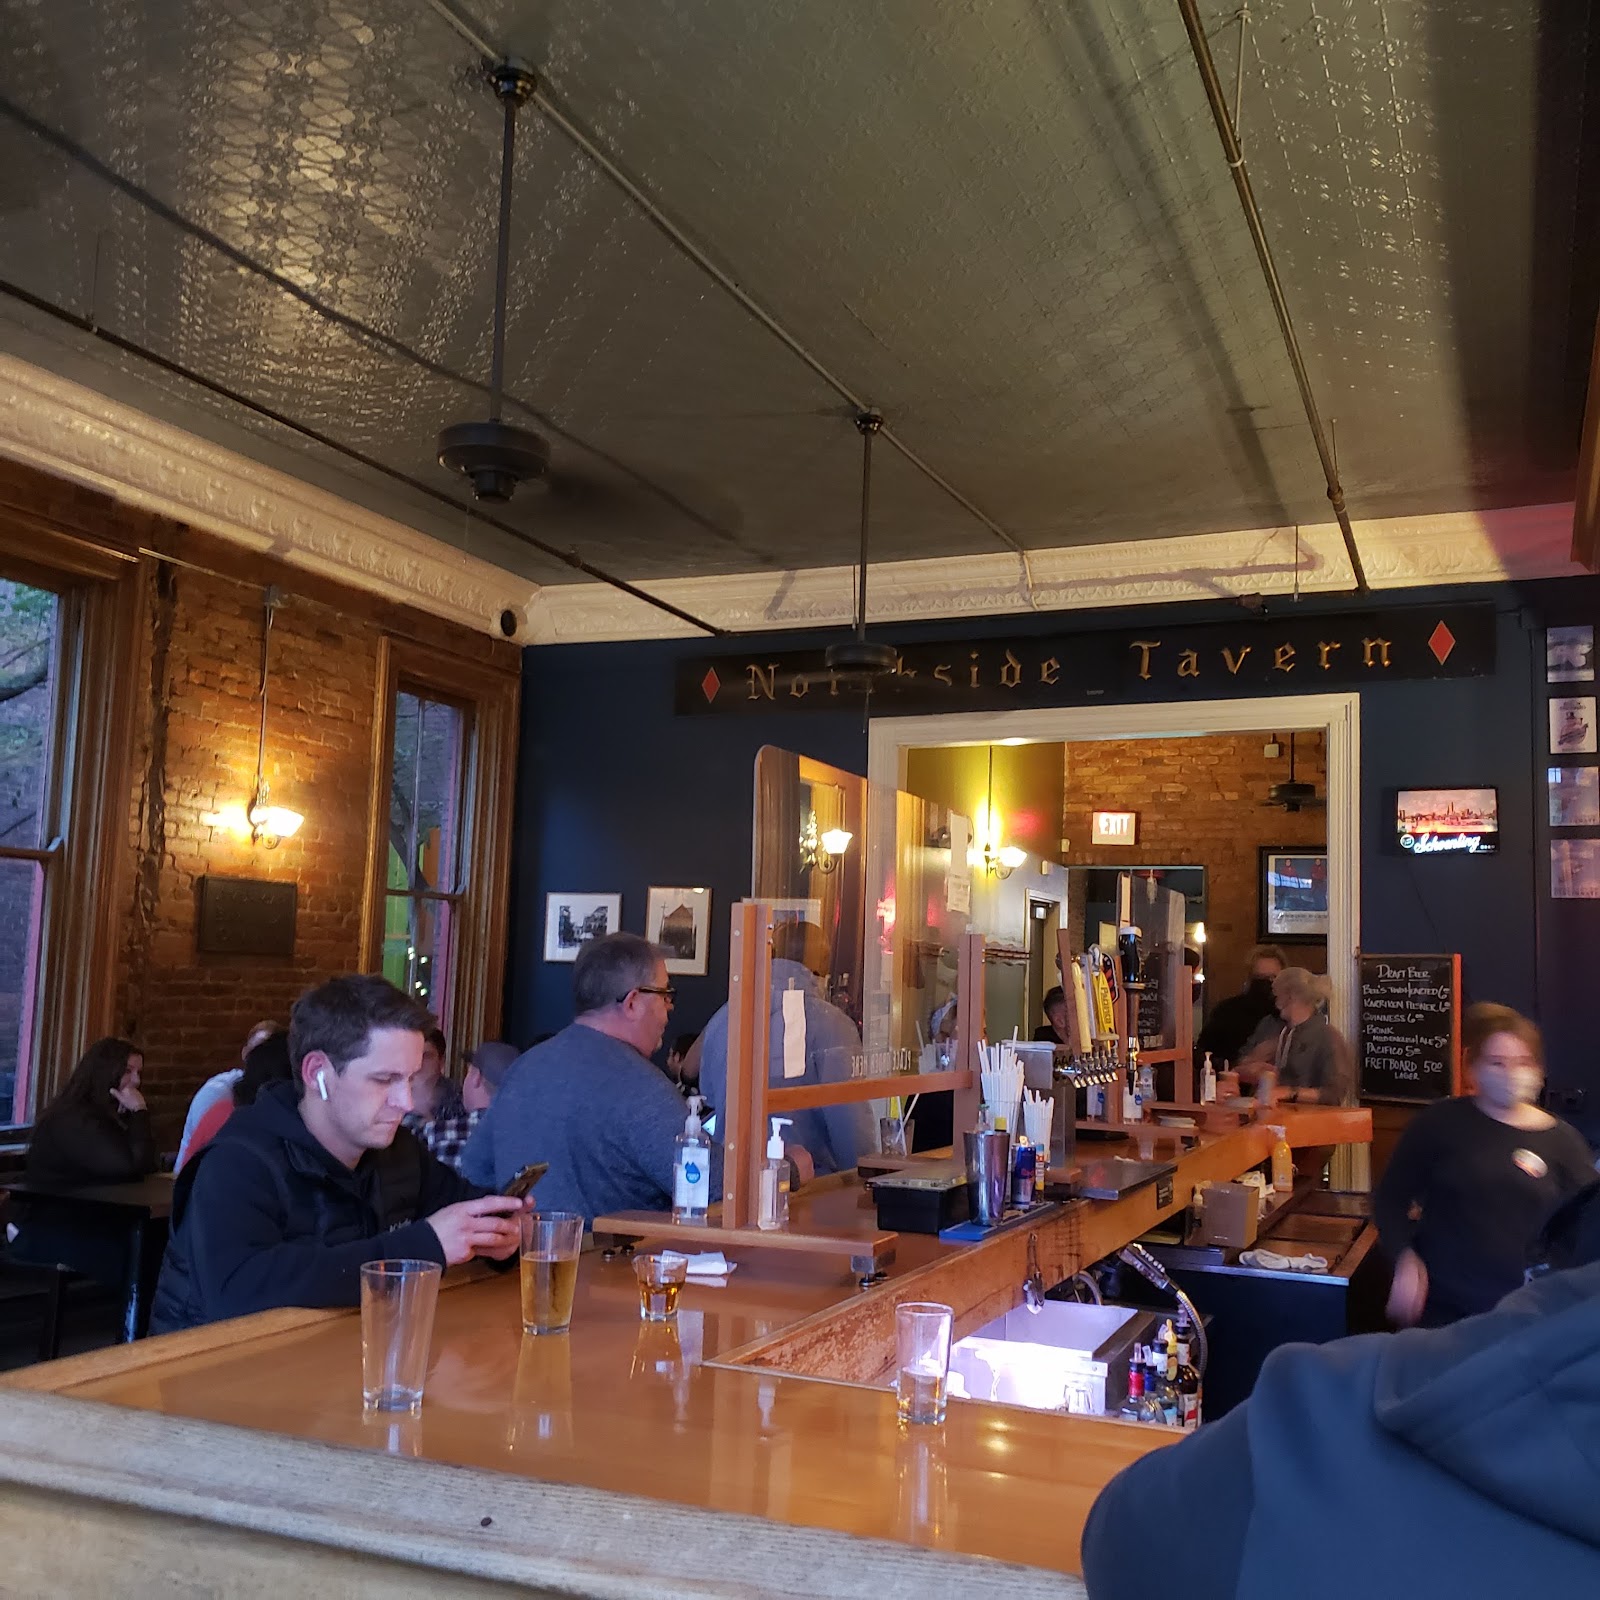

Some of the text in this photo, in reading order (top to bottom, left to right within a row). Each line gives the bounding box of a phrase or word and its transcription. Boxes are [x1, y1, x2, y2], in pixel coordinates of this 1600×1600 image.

[1128, 636, 1393, 681] Tavern
[1376, 964, 1430, 978] DRAFT BEER
[1362, 1012, 1406, 1022] GUINNESS
[1366, 1042, 1403, 1055] PACIFICO
[1394, 1073, 1420, 1081] LAGER
